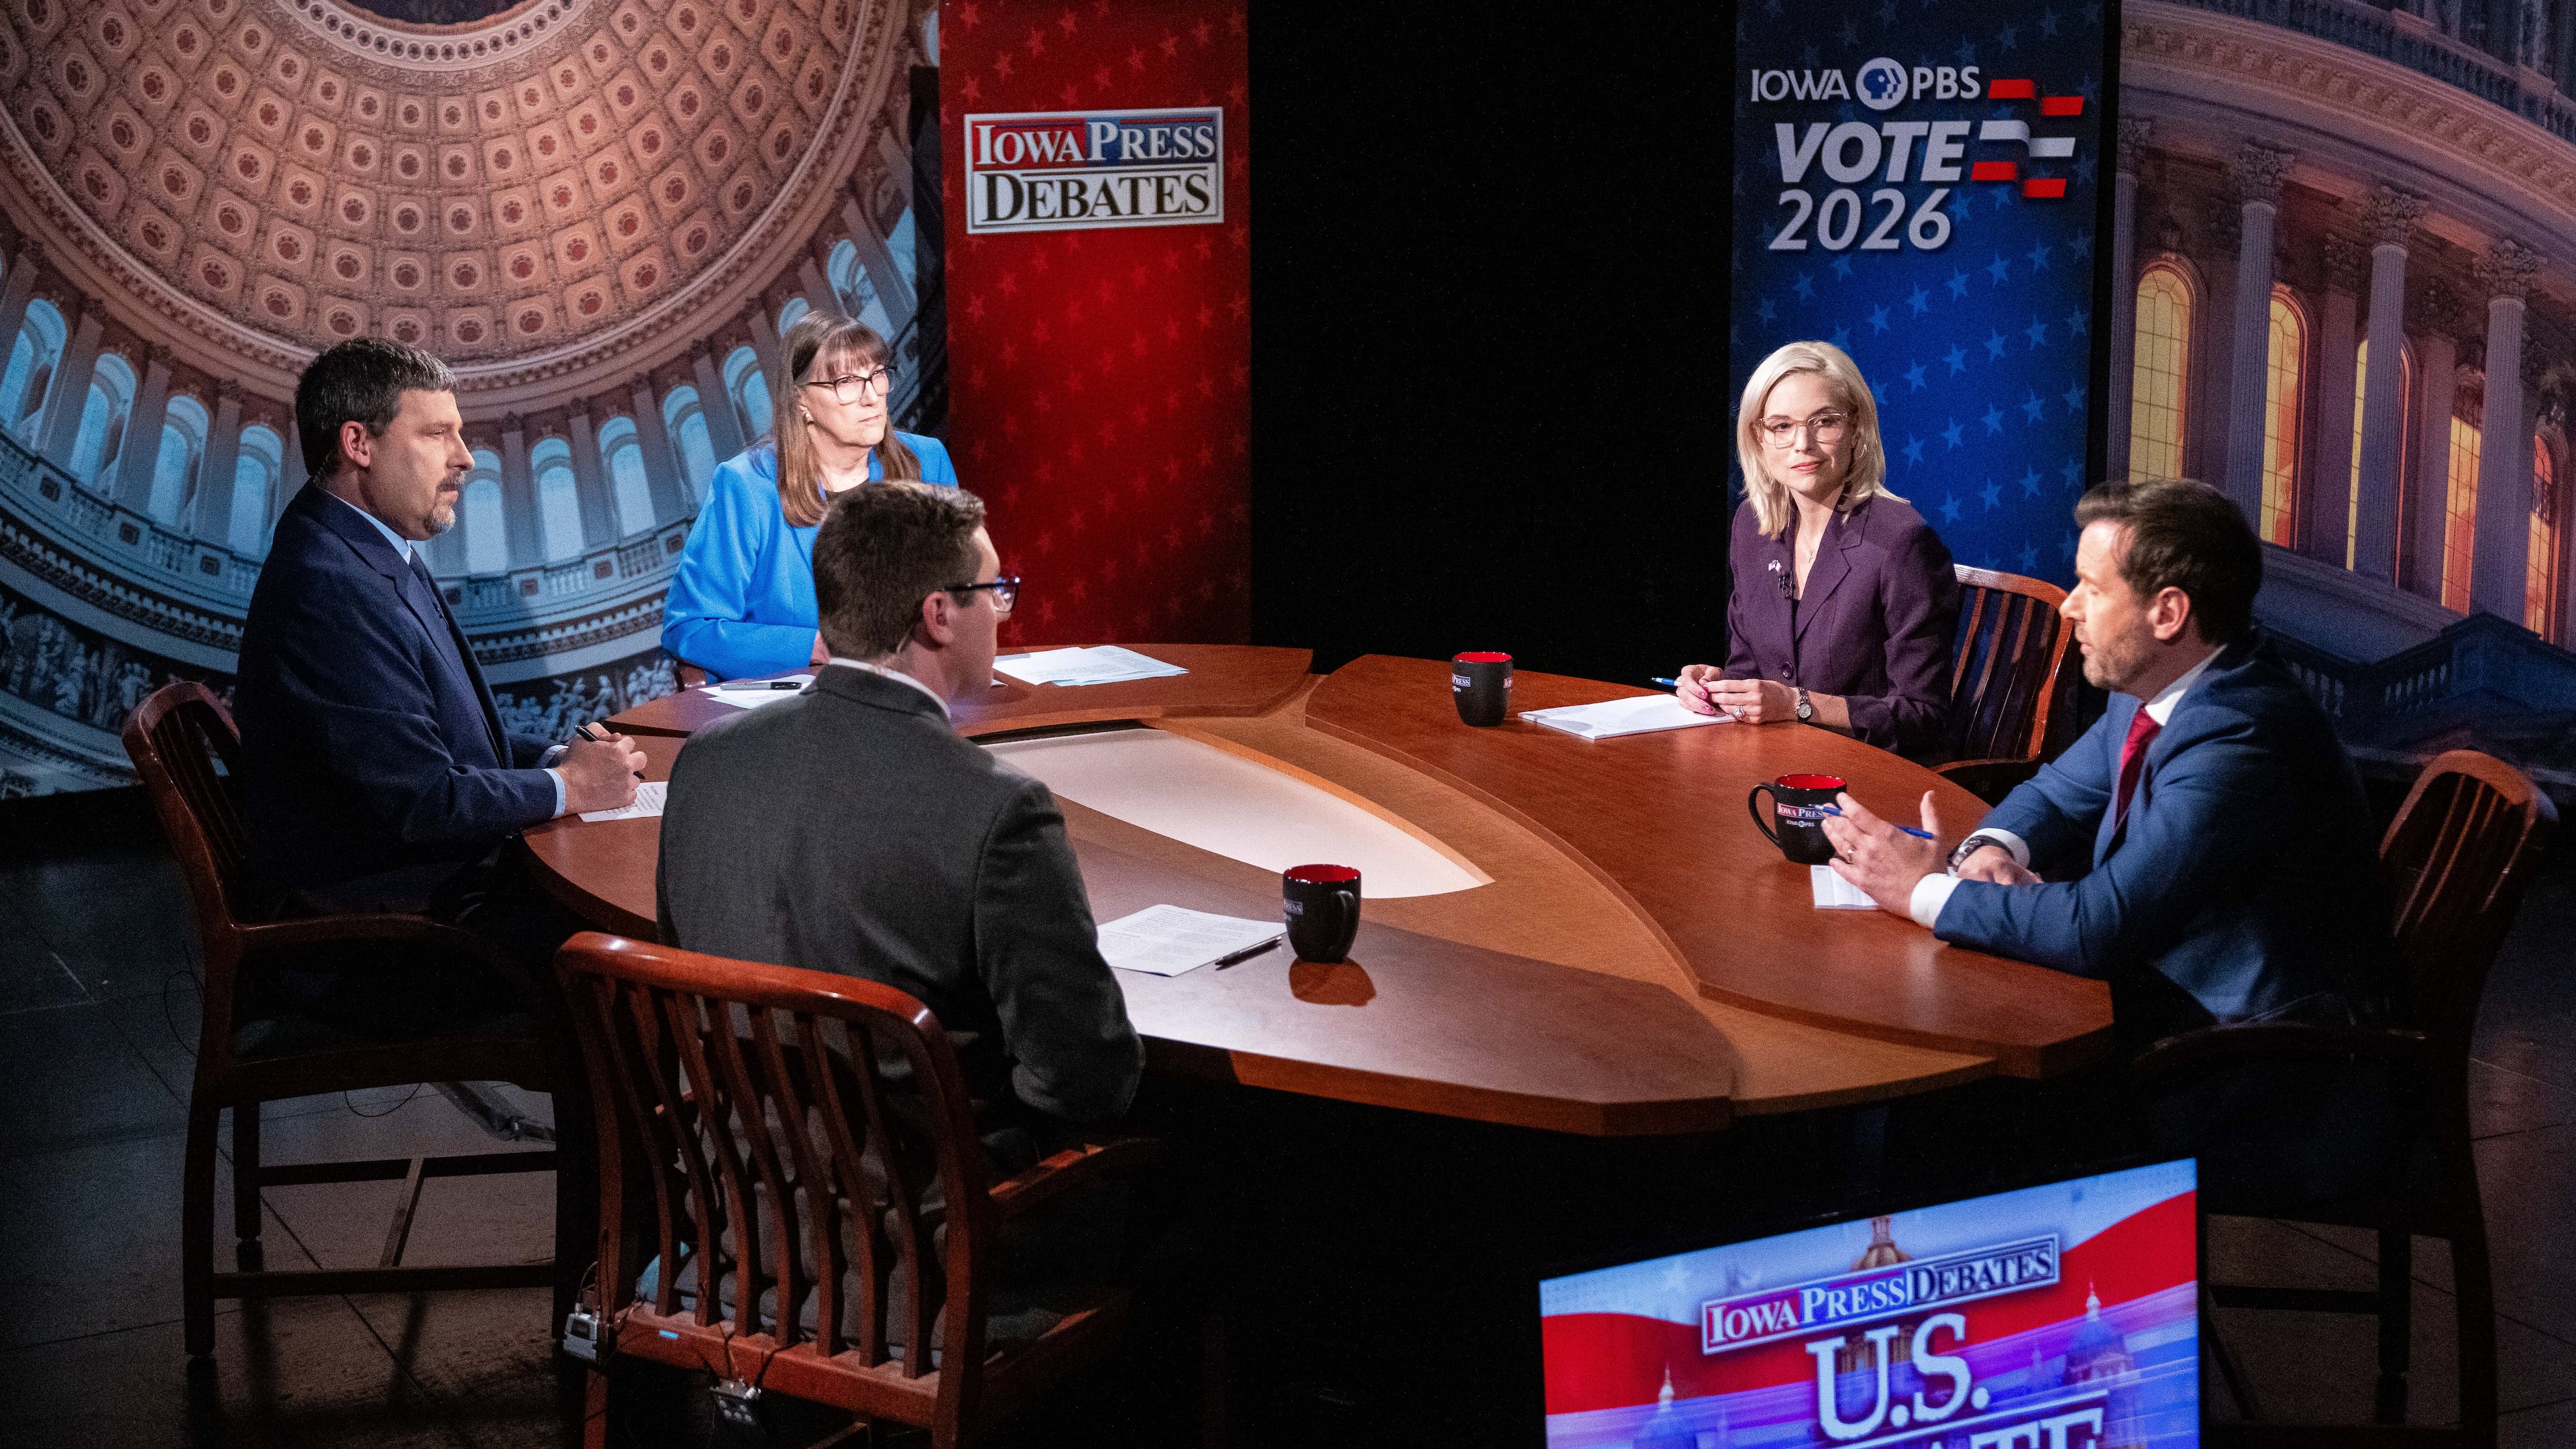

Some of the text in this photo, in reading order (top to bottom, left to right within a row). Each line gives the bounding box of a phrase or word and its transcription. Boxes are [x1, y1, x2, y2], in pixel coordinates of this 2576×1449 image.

[1750, 66, 1981, 102] IOWA PBS
[975, 121, 1216, 166] IOWA PRESS
[1774, 119, 1971, 184] VOTE
[981, 173, 1210, 222] DEBATES
[1768, 188, 1951, 251] 2026
[1778, 804, 1823, 817] IOWA PRES
[1708, 1249, 2053, 1344] IOWA PRESS DEBATES
[1806, 1313, 1990, 1440] U.S.
